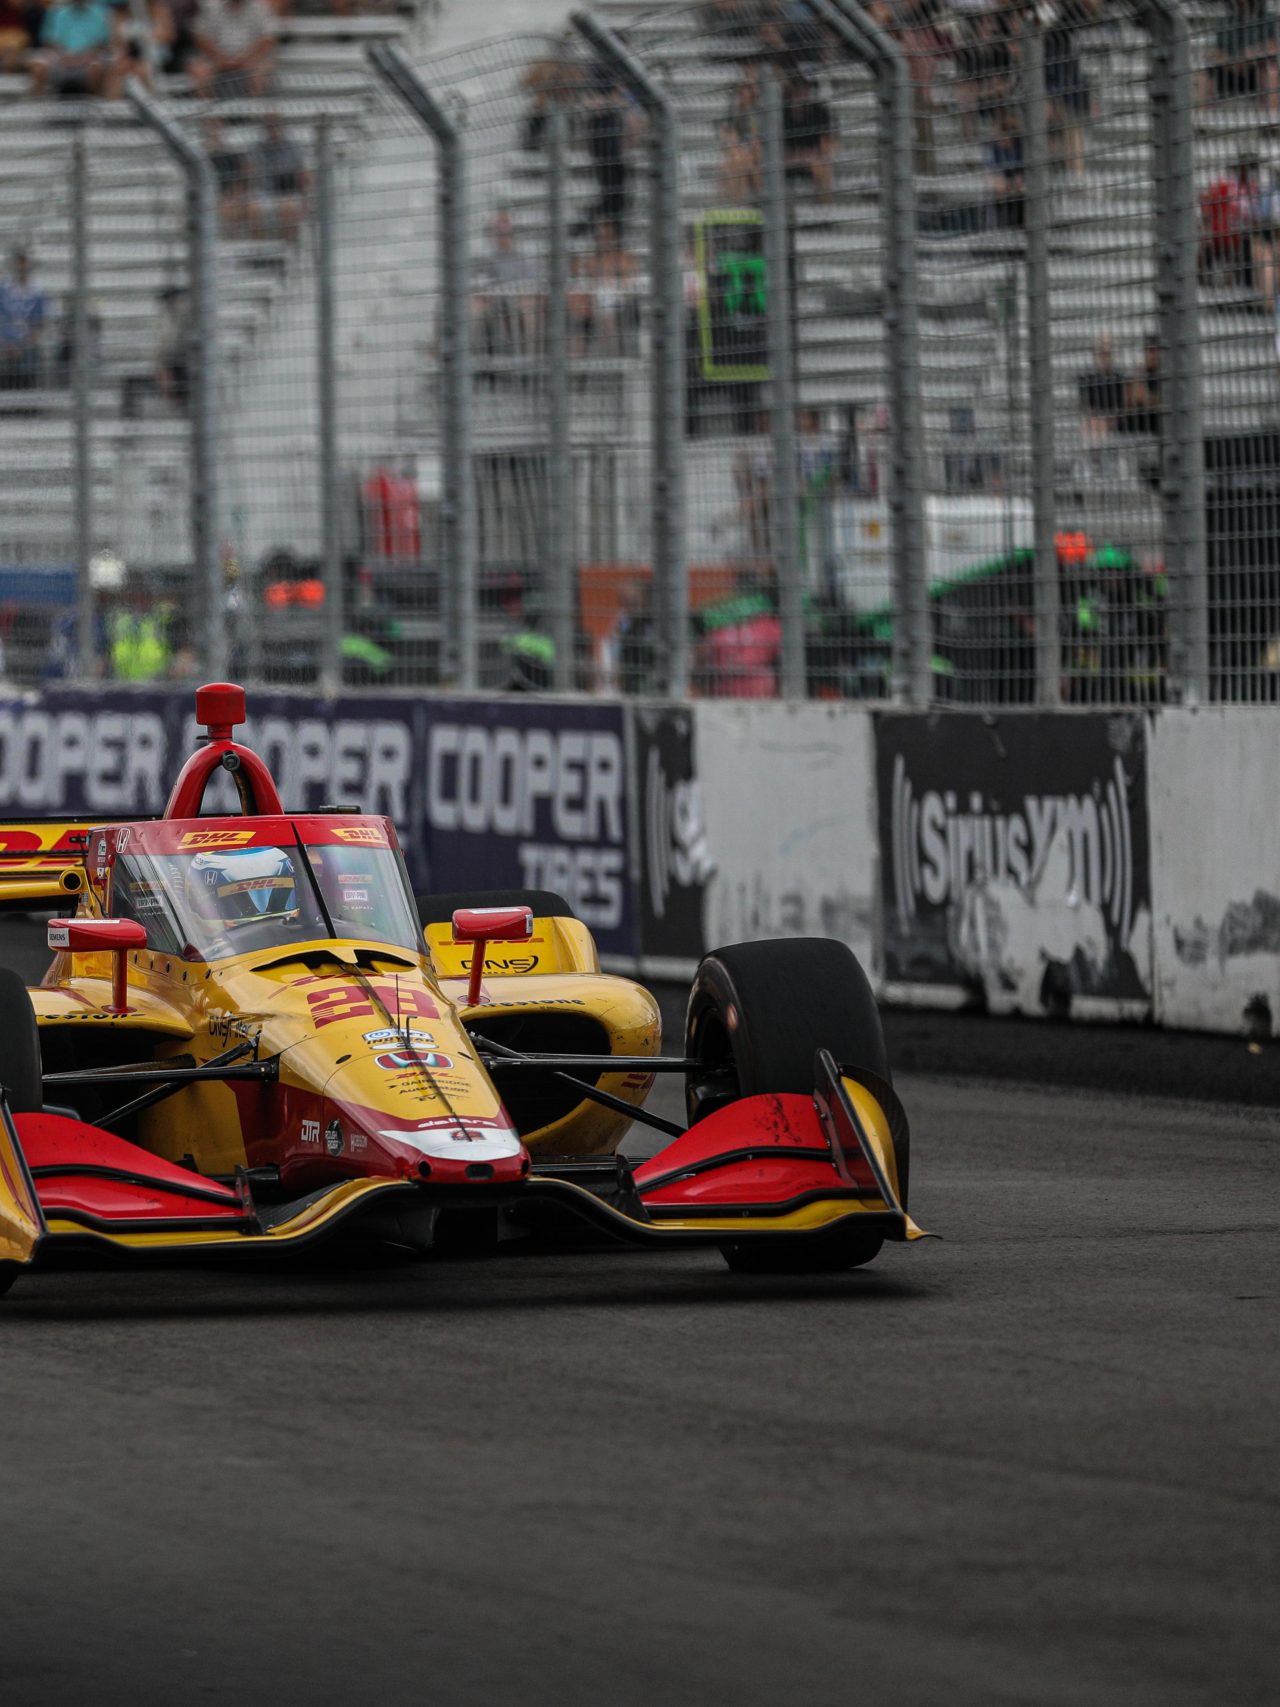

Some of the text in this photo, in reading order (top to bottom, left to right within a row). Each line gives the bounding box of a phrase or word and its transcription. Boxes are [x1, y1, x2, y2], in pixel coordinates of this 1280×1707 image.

[427, 723, 623, 845] COOPER
[189, 830, 240, 846] DHL
[342, 827, 382, 841] DHL
[235, 877, 278, 892] DHL
[518, 843, 624, 931] TIRES
